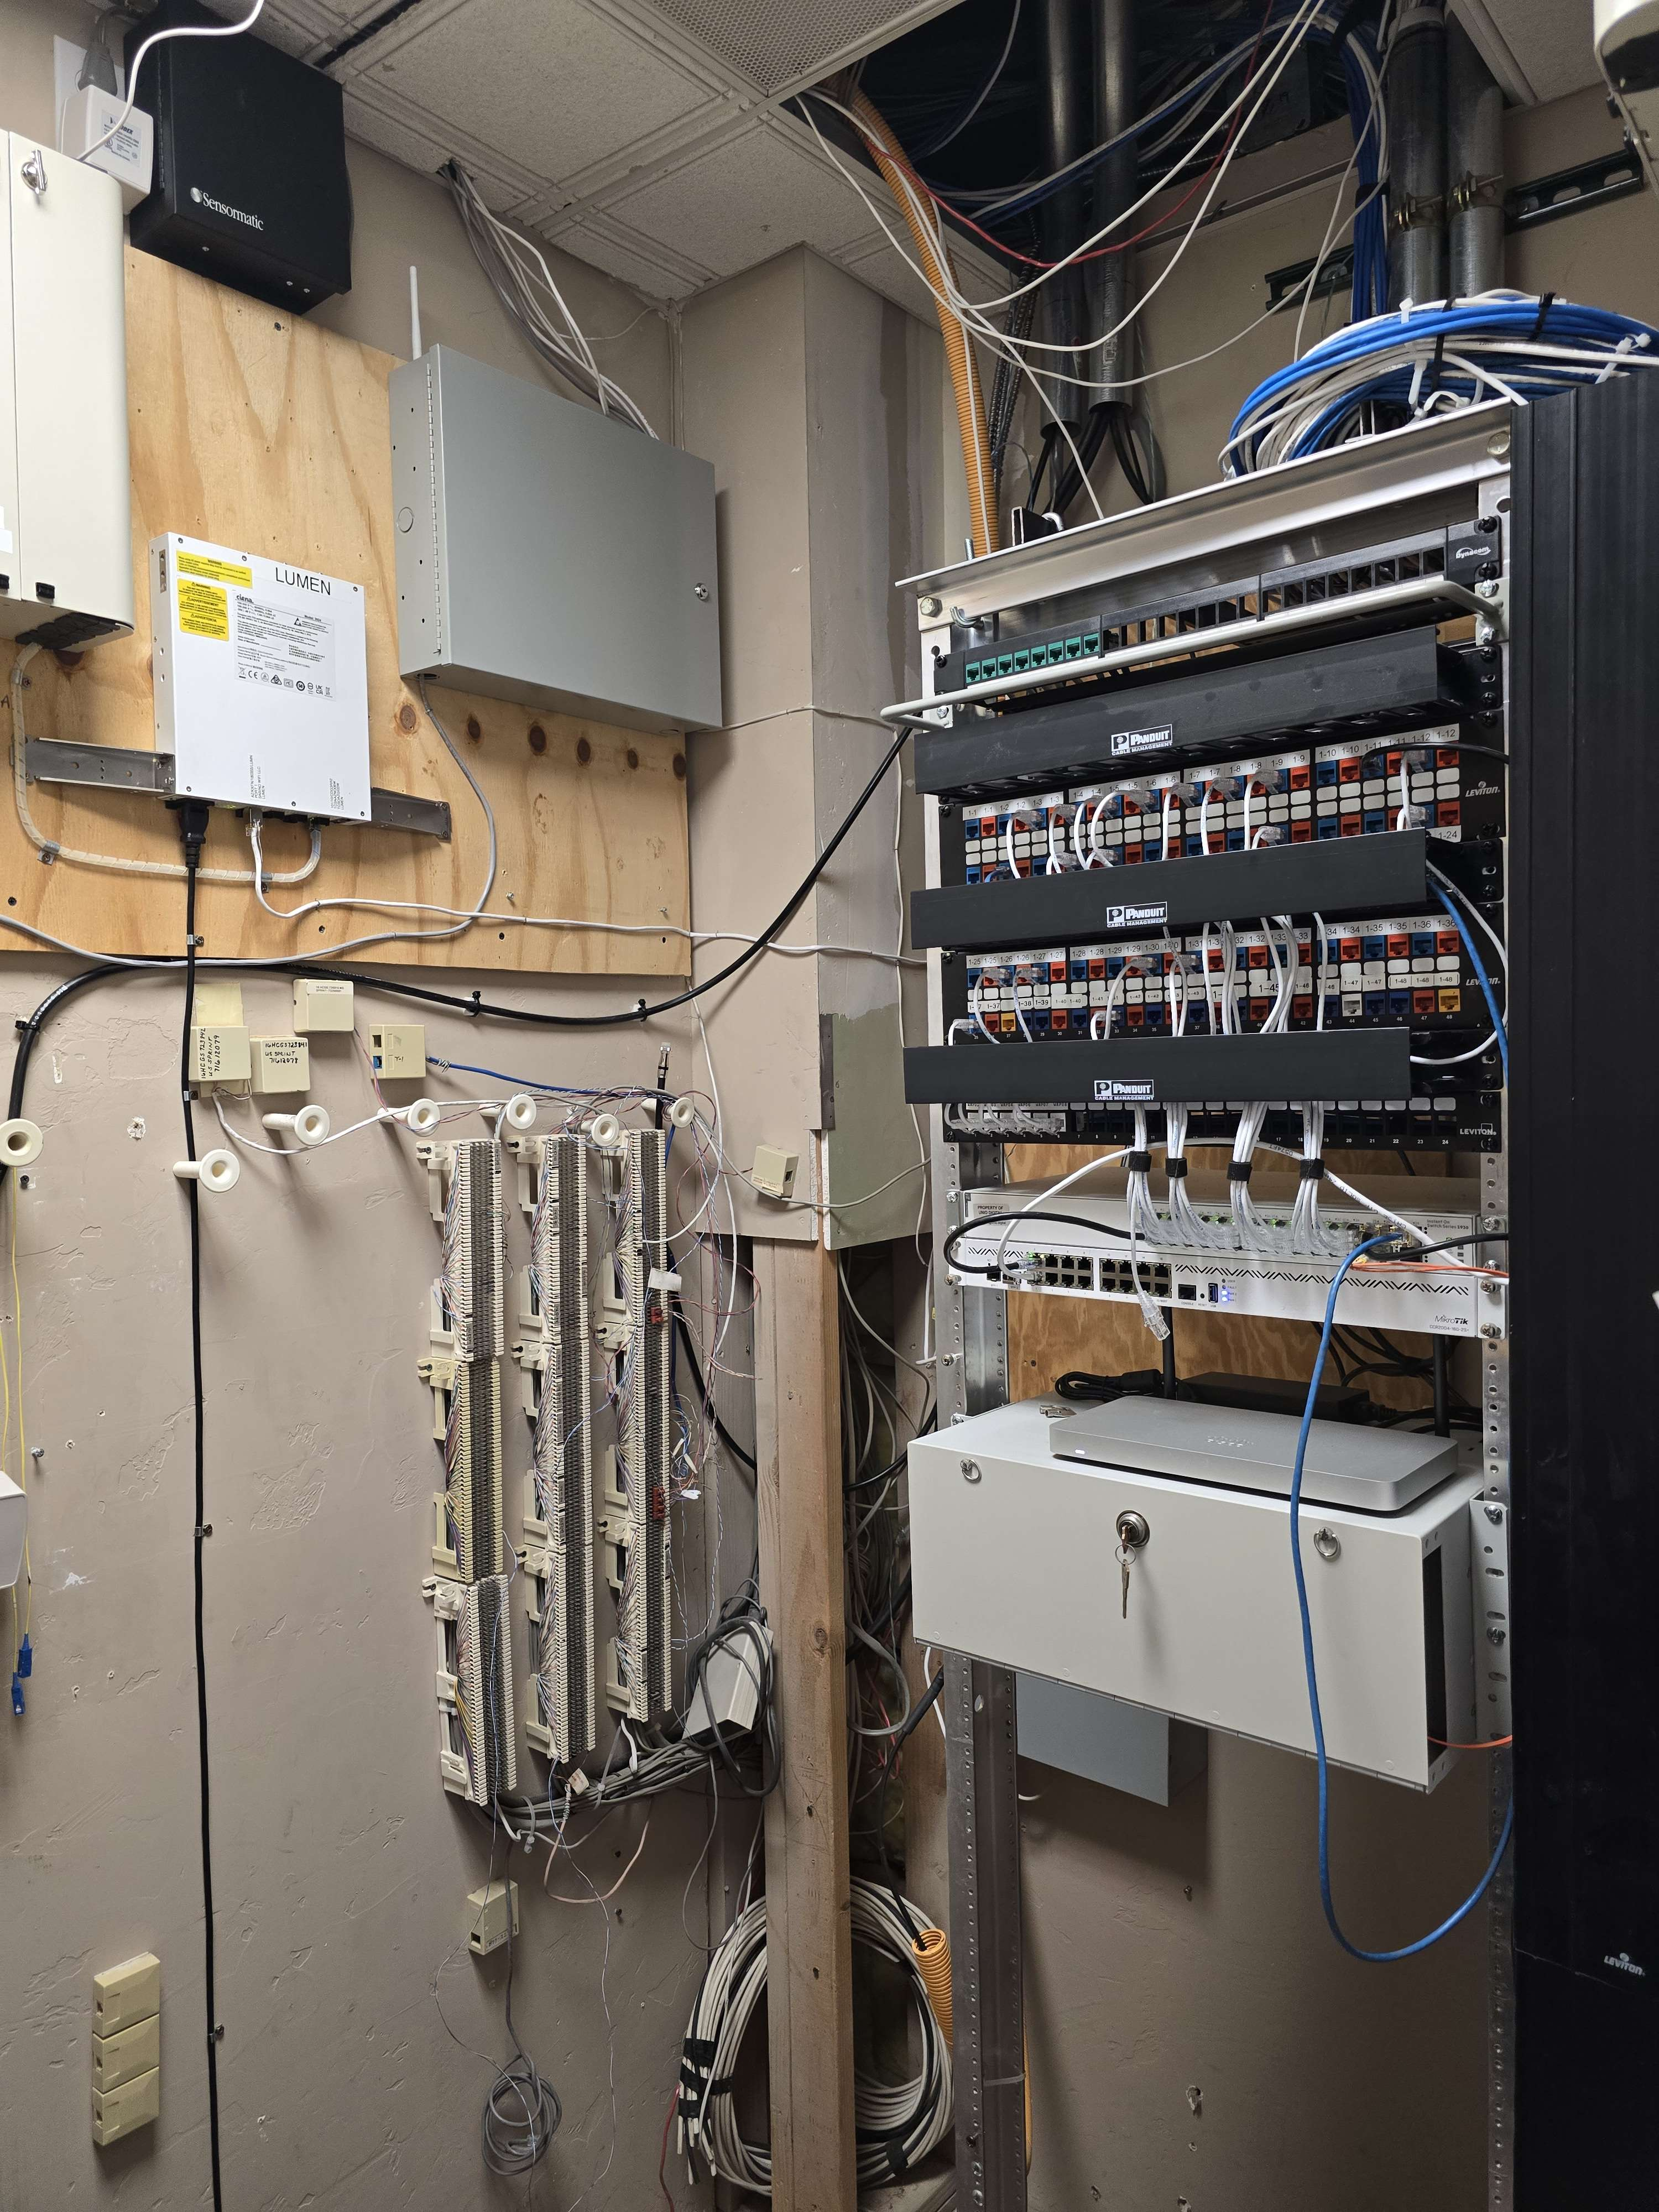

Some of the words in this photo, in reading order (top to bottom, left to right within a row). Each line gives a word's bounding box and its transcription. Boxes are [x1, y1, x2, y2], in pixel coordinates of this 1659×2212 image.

[203, 192, 264, 231] Sensormatic
[1455, 546, 1491, 559] Dynacom
[275, 567, 331, 596] LUMEN
[1130, 730, 1170, 745] PANDUIT
[1319, 749, 1336, 758] 1-10
[1342, 745, 1359, 755] 1-10
[1412, 733, 1431, 743] 1-12
[1436, 729, 1455, 739] 1-12
[1131, 742, 1172, 753] MANAGEMENT
[1190, 771, 1200, 779] 1-7
[1210, 768, 1220, 776] 1-7
[1271, 759, 1283, 767] 1-9
[1293, 754, 1305, 763] 1-9
[1438, 831, 1457, 839] 1-24
[1125, 907, 1165, 919] PANDUIT
[1326, 927, 1337, 936] -34
[1343, 925, 1360, 934] 1-34
[1365, 924, 1383, 932] 1-35
[1389, 921, 1407, 930] 1-35
[1412, 920, 1431, 928] 1-36
[1437, 918, 1456, 927] 1-36
[1113, 1083, 1151, 1094] PANDUIT
[1434, 1315, 1469, 1325] MikroTik
